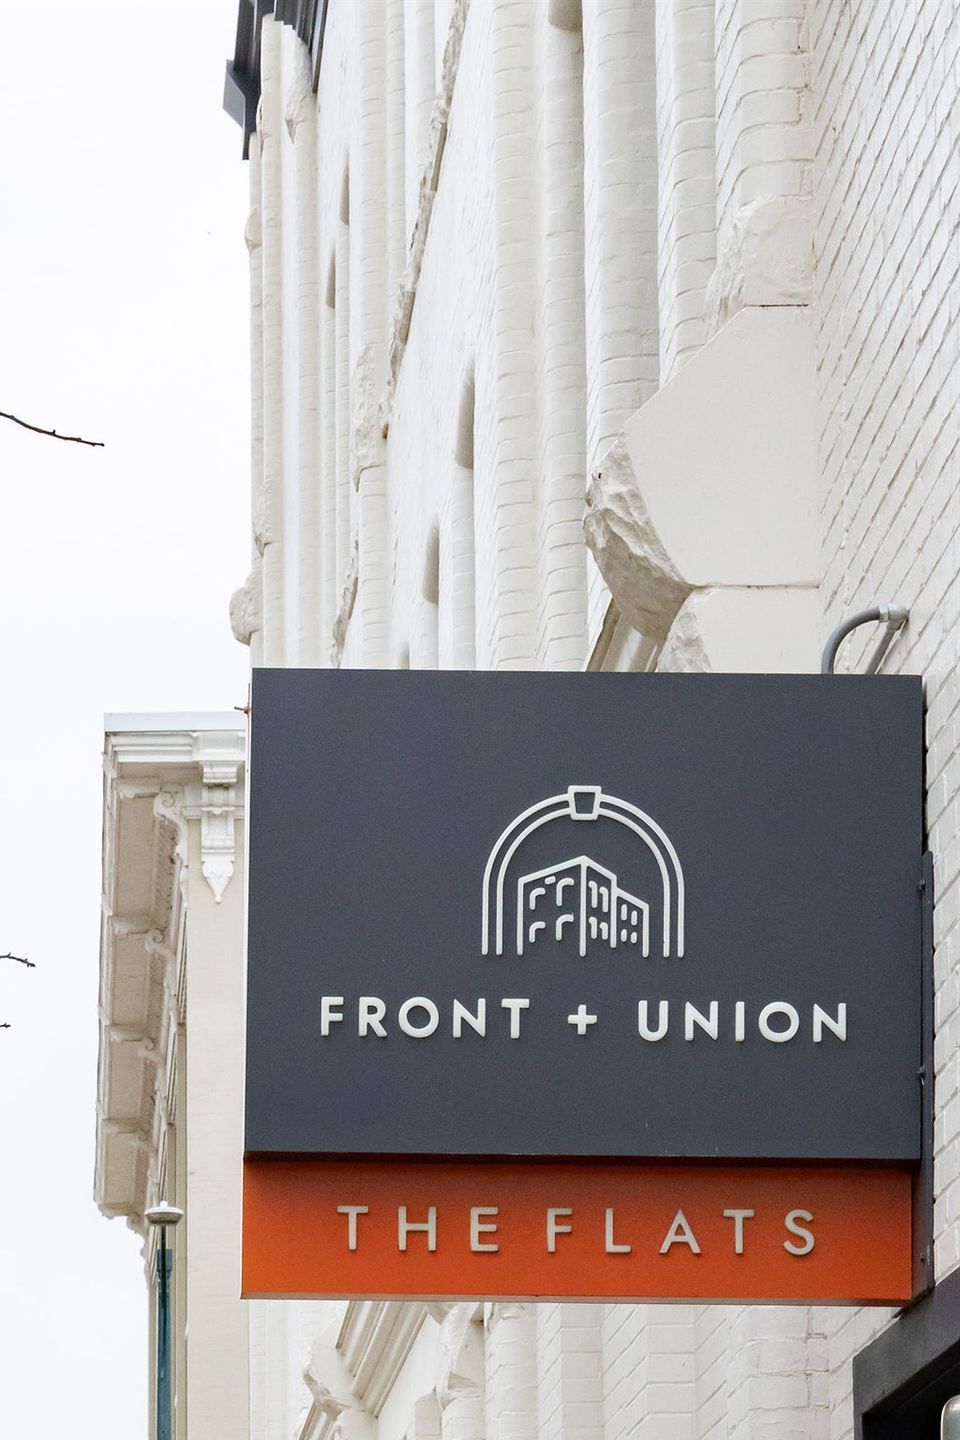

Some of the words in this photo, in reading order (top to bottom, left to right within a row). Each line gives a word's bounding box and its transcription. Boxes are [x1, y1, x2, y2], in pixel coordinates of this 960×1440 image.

[320, 996, 531, 1040] FRONT
[637, 1000, 849, 1043] UNION
[336, 1205, 499, 1254] THE
[546, 1207, 816, 1257] FLATS
